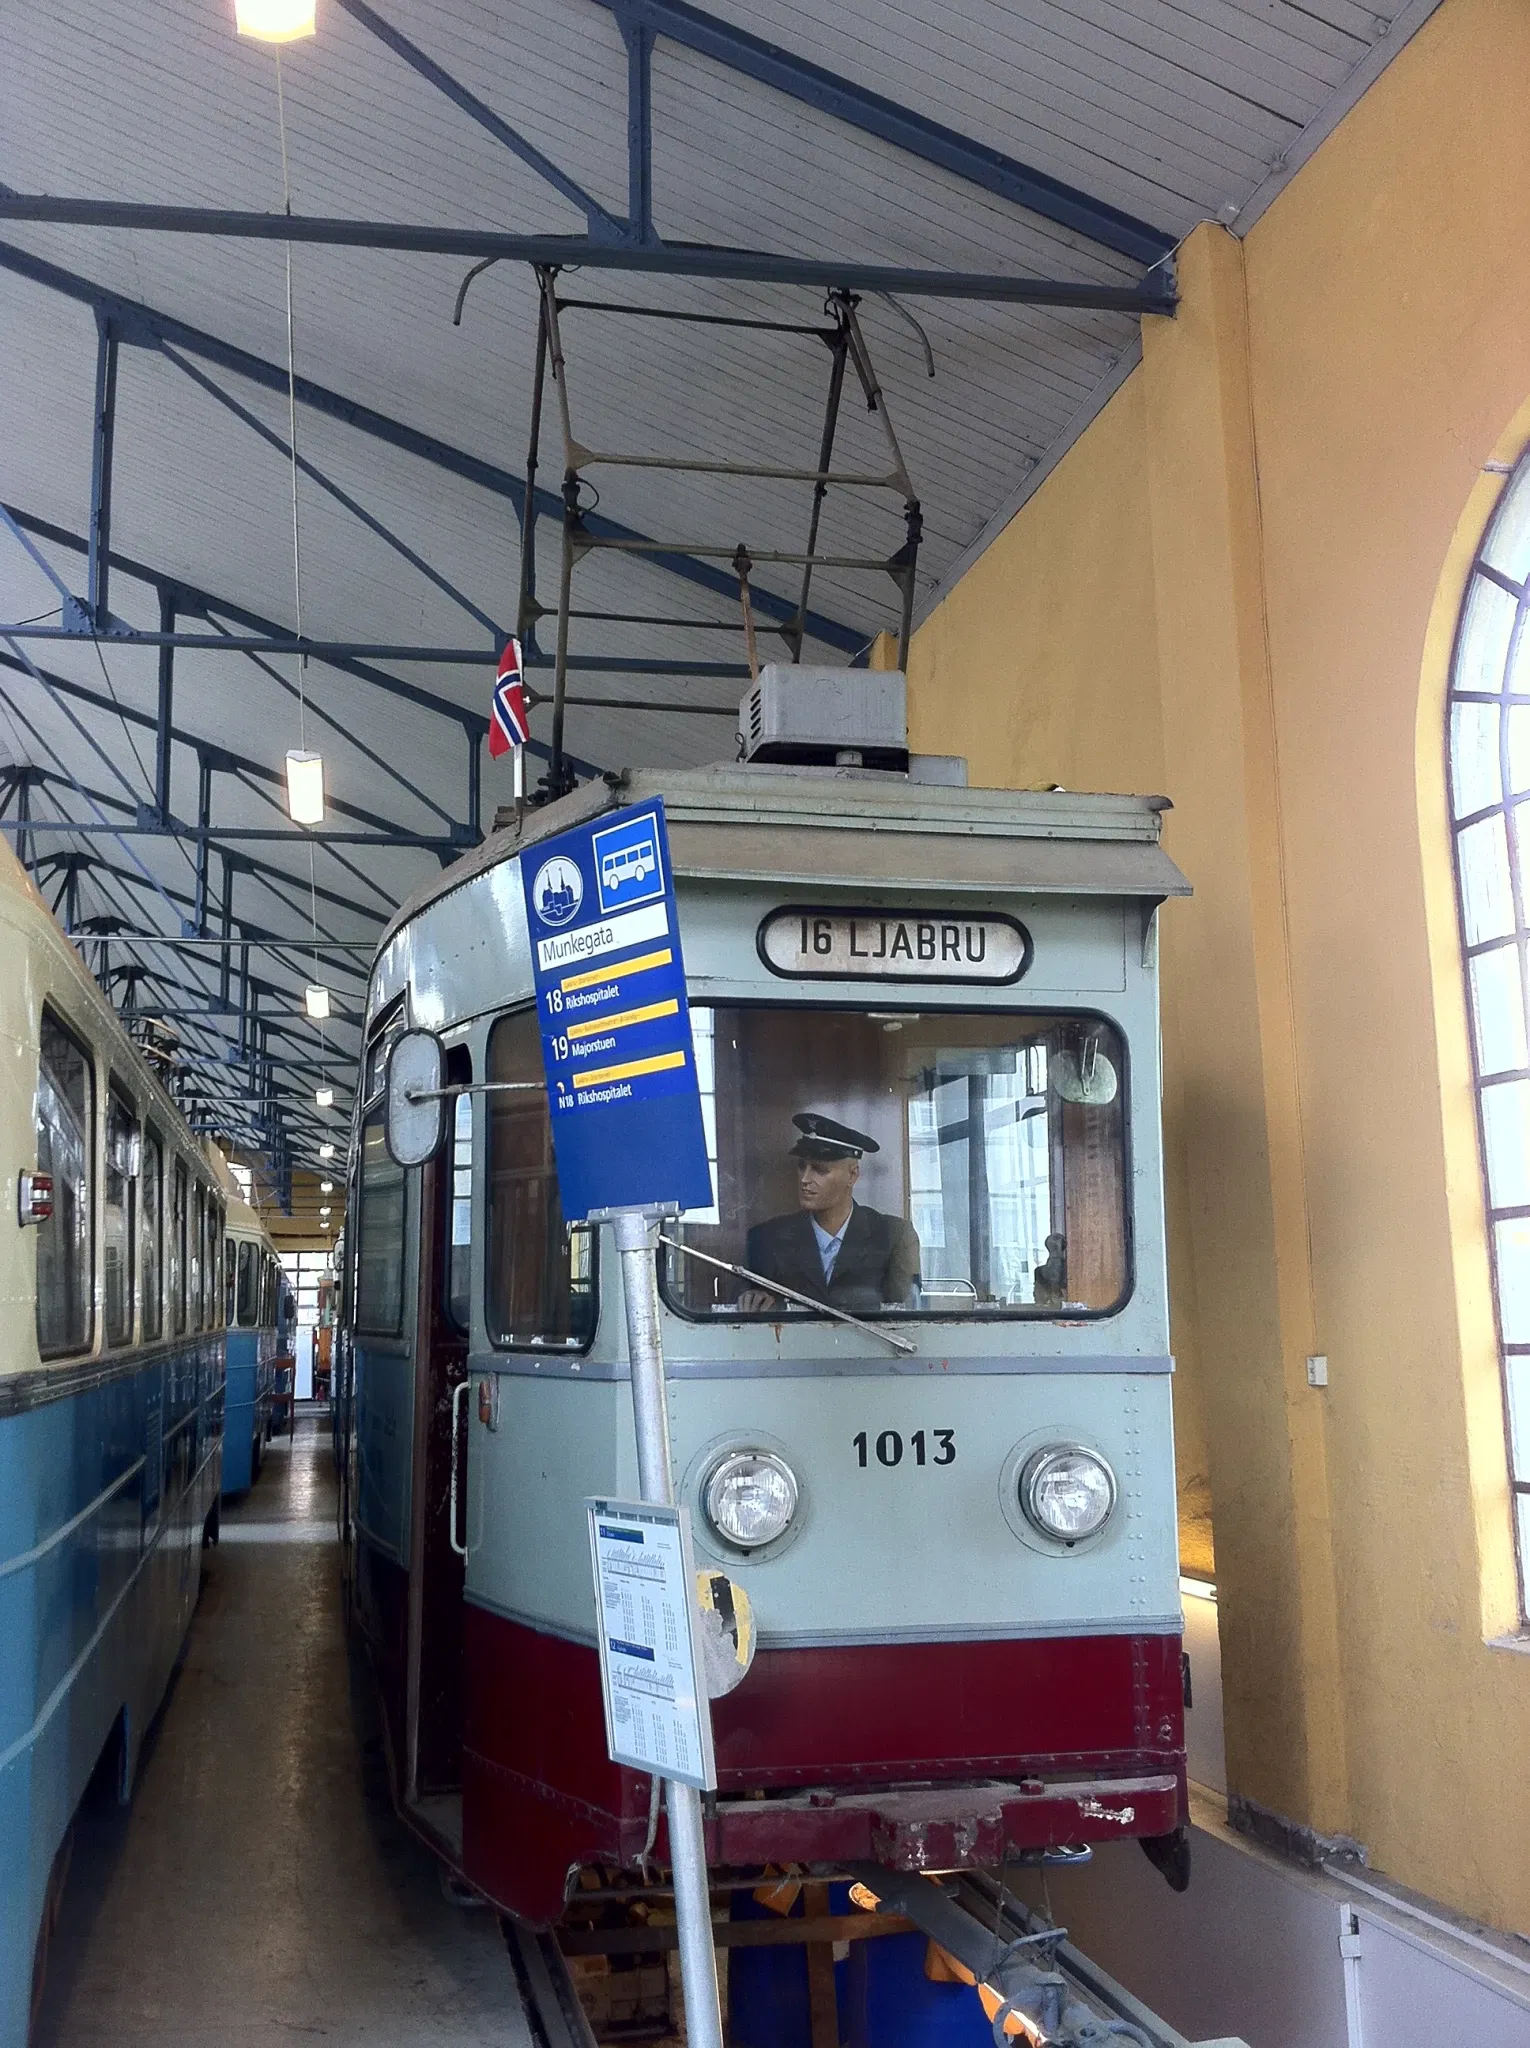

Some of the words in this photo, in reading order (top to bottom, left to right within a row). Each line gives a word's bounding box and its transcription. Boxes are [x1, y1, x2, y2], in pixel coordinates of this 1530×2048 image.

[543, 927, 614, 963] Munkegata
[800, 919, 832, 955] 16
[850, 921, 986, 963] LJABRU
[546, 989, 563, 1014] 18
[566, 984, 620, 1010] Rikshospitalet
[552, 1035, 569, 1061] 19
[572, 1036, 616, 1058] Majorstuen
[558, 1094, 574, 1110] N18
[577, 1083, 632, 1106] Rikshospitalet
[853, 1429, 957, 1468] 1013
